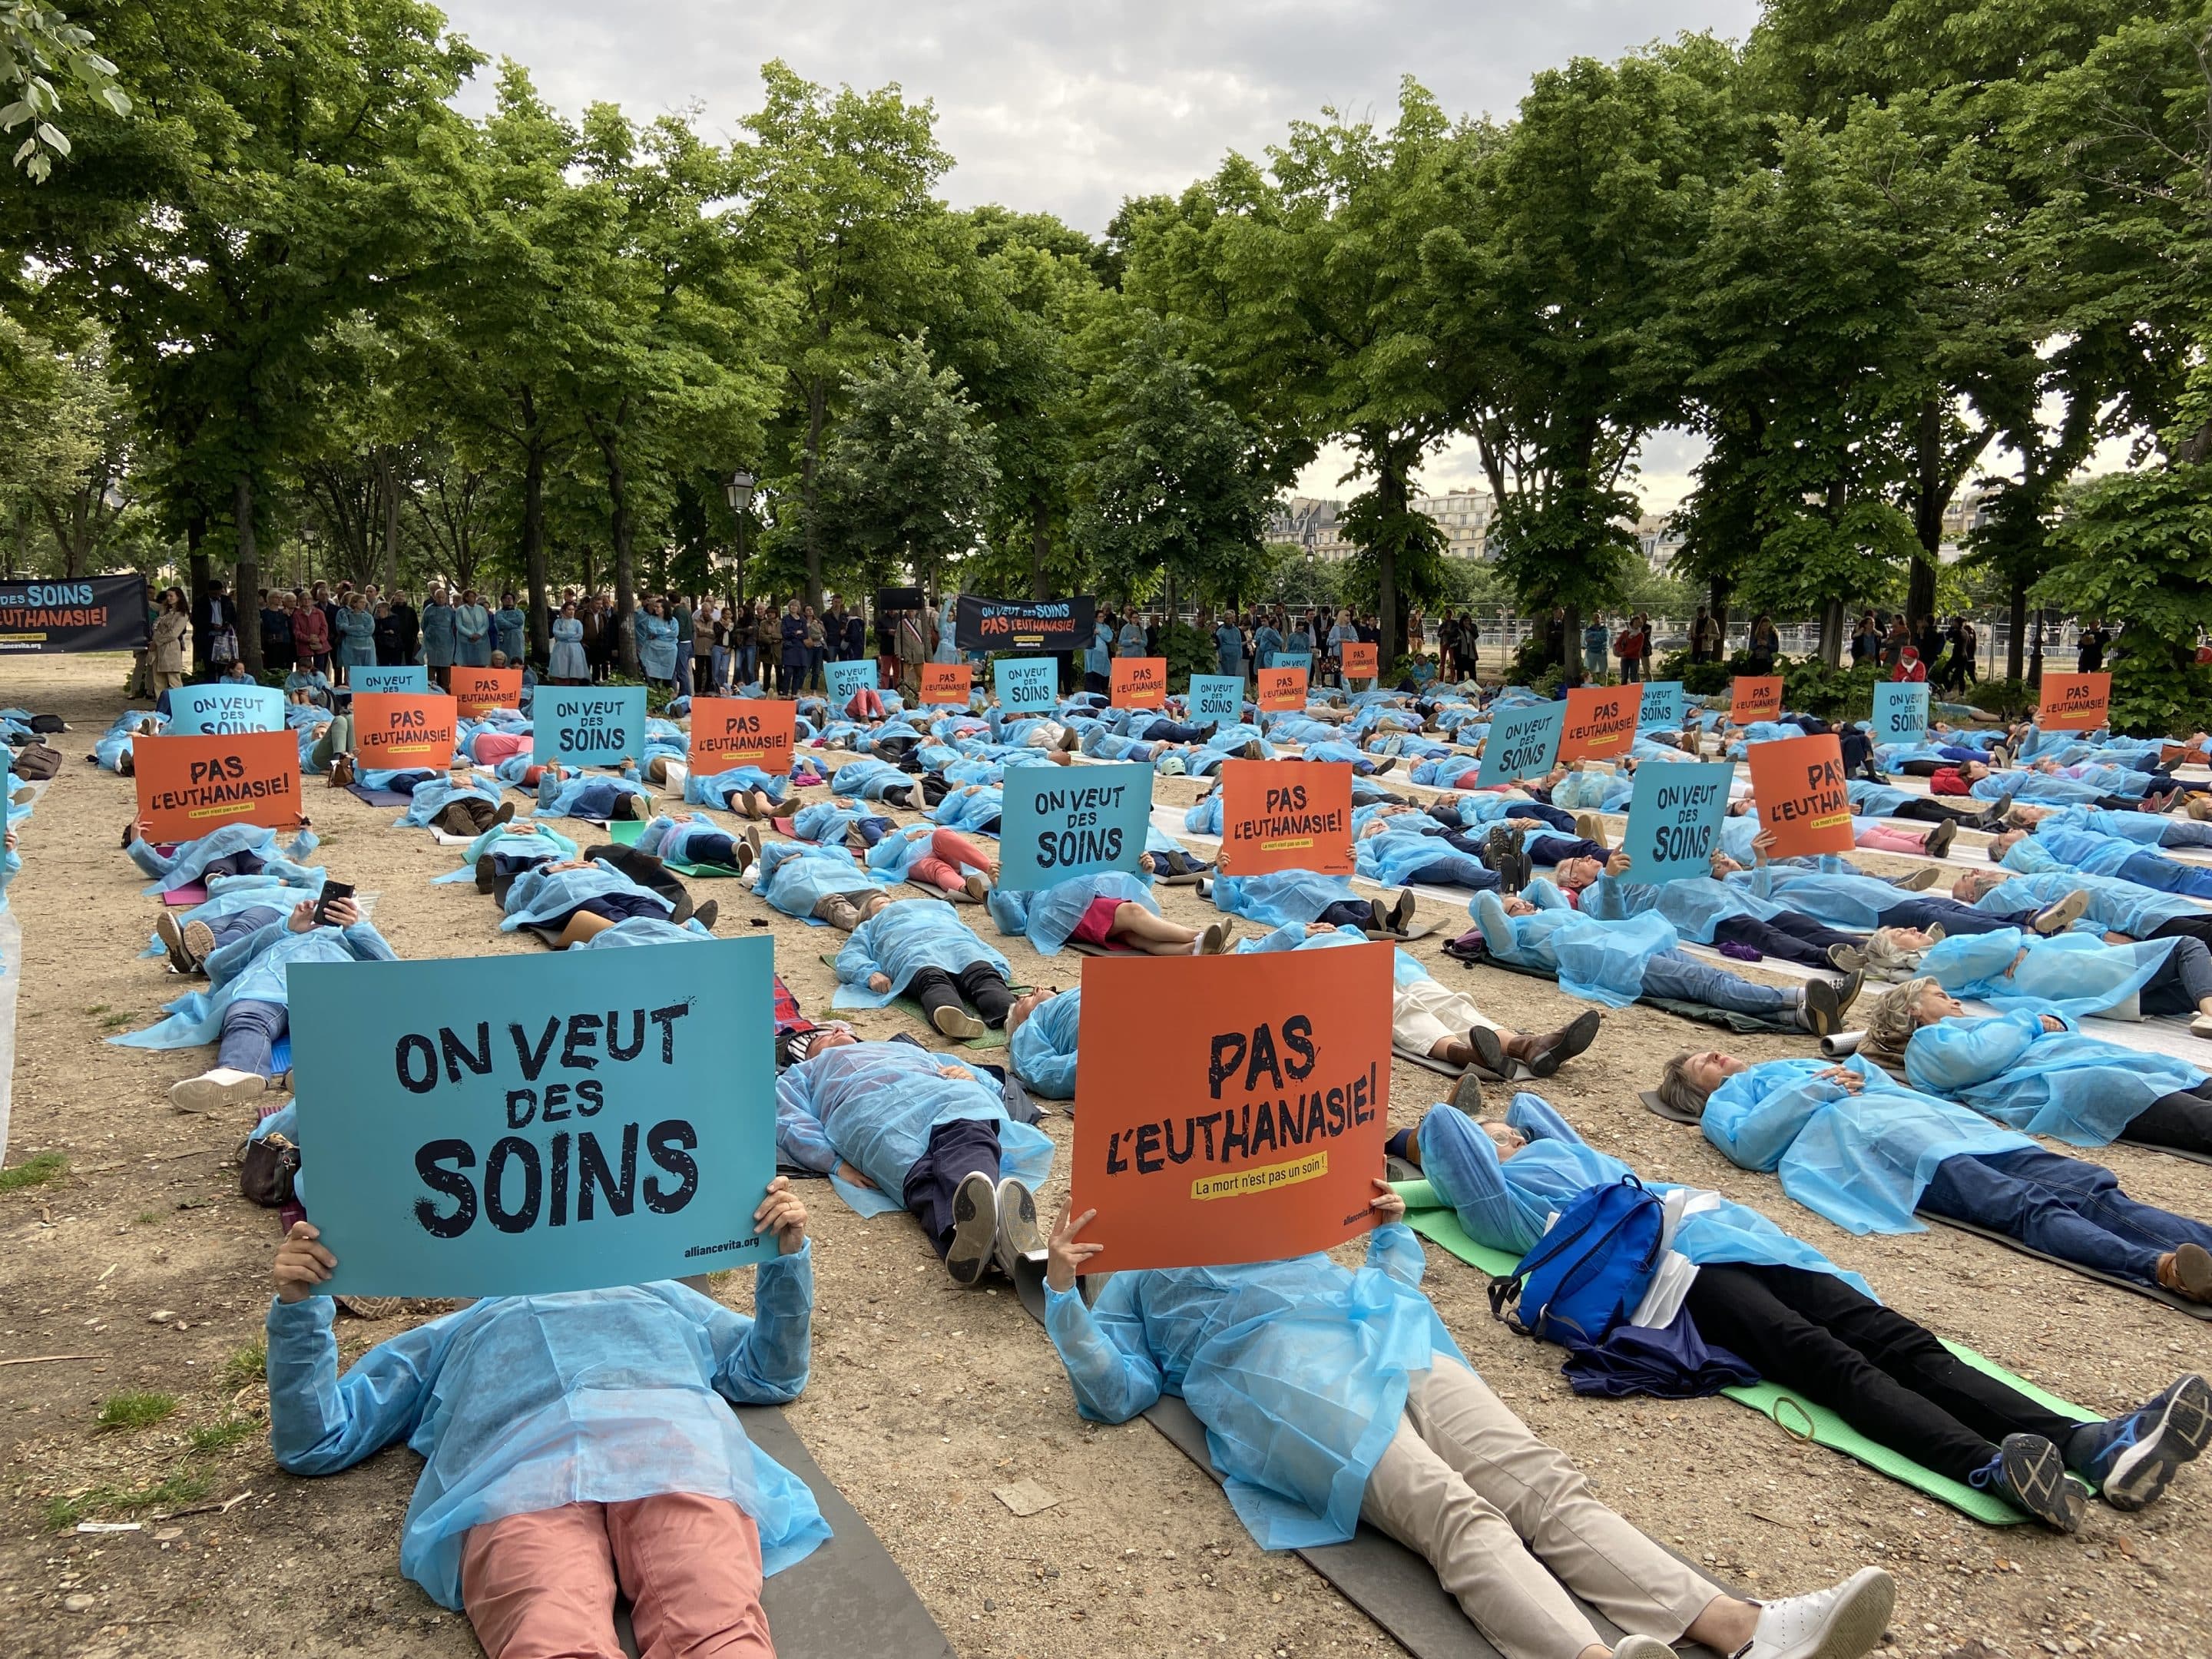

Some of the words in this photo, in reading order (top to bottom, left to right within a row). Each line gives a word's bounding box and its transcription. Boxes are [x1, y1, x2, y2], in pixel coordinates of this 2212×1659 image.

[0, 594, 25, 605] DES
[27, 585, 94, 607] SOINS
[982, 607, 995, 618] ON
[996, 606, 1020, 615] VEUT
[1035, 603, 1070, 618] SOINS
[980, 616, 1009, 636] PAS
[1012, 618, 1075, 632] L'EUTHANASIE!
[366, 676, 381, 687] ON
[383, 675, 413, 686] VEUT
[834, 670, 846, 679] ON
[846, 667, 867, 677] VEUT
[939, 673, 955, 683] PAS
[1008, 669, 1022, 680] ON
[1023, 667, 1048, 678] VEUT
[1133, 668, 1151, 681] PAS
[1277, 677, 1293, 687] PAS
[475, 680, 499, 692] PAS
[1012, 685, 1049, 703] SOINS
[1200, 684, 1212, 694] ON
[1213, 684, 1234, 694] VEUT
[1651, 690, 1672, 700] VEUT
[1753, 687, 1770, 699] PAS
[2066, 685, 2089, 700] PAS
[194, 697, 217, 713] ON
[220, 697, 264, 713] VEUT
[557, 702, 578, 717] ON
[582, 701, 624, 717] VEUT
[1200, 699, 1233, 714] SOINS
[1889, 694, 1903, 706] ON
[1904, 694, 1923, 705] VEUT
[2046, 696, 2104, 714] L'EUTHANASIE!
[220, 711, 245, 720] DES
[390, 710, 426, 729] PAS
[1592, 701, 1619, 722] PAS
[1641, 706, 1671, 721] SOINS
[581, 717, 604, 727] DES
[726, 716, 761, 735] PAS
[1505, 723, 1522, 740] ON
[1523, 716, 1553, 736] VEUT
[1569, 714, 1634, 740] L'EUTHANASIE!
[1890, 714, 1923, 732] SOINS
[363, 727, 451, 746] L'EUTHANASIE!
[559, 728, 625, 752] SOINS
[699, 732, 787, 751] L'EUTHANASIE!
[1519, 733, 1536, 748] DES
[1499, 743, 1546, 773] SOINS
[190, 756, 246, 785] PAS
[151, 772, 290, 811] L'EUTHANASIE!
[1035, 790, 1065, 815] ON
[1070, 785, 1126, 812] VEUT
[1267, 785, 1308, 814] PAS
[1657, 785, 1680, 810] ON
[1683, 784, 1718, 808] VEUT
[1068, 812, 1097, 829] DES
[1234, 809, 1342, 840] L'EUTHANASIE!
[1678, 809, 1699, 825] DES
[1037, 827, 1124, 869] SOINS
[1652, 825, 1712, 863] SOINS
[395, 1020, 493, 1095] ON
[508, 1001, 690, 1081] VEUT
[1208, 1015, 1318, 1100] PAS
[505, 1079, 604, 1129] DES
[1106, 1061, 1376, 1176] L'EUTHANASIE!
[411, 1119, 699, 1239] SOINS
[1195, 1181, 1209, 1195] La
[1212, 1177, 1239, 1194] mort
[1241, 1173, 1266, 1187] n'est
[1268, 1169, 1286, 1186] pas
[1288, 1167, 1300, 1178] un
[1302, 1157, 1320, 1174] soin
[1321, 1155, 1325, 1168] !
[1343, 1207, 1376, 1227] alliancevita.org
[684, 1237, 760, 1258] alliancevita.org
